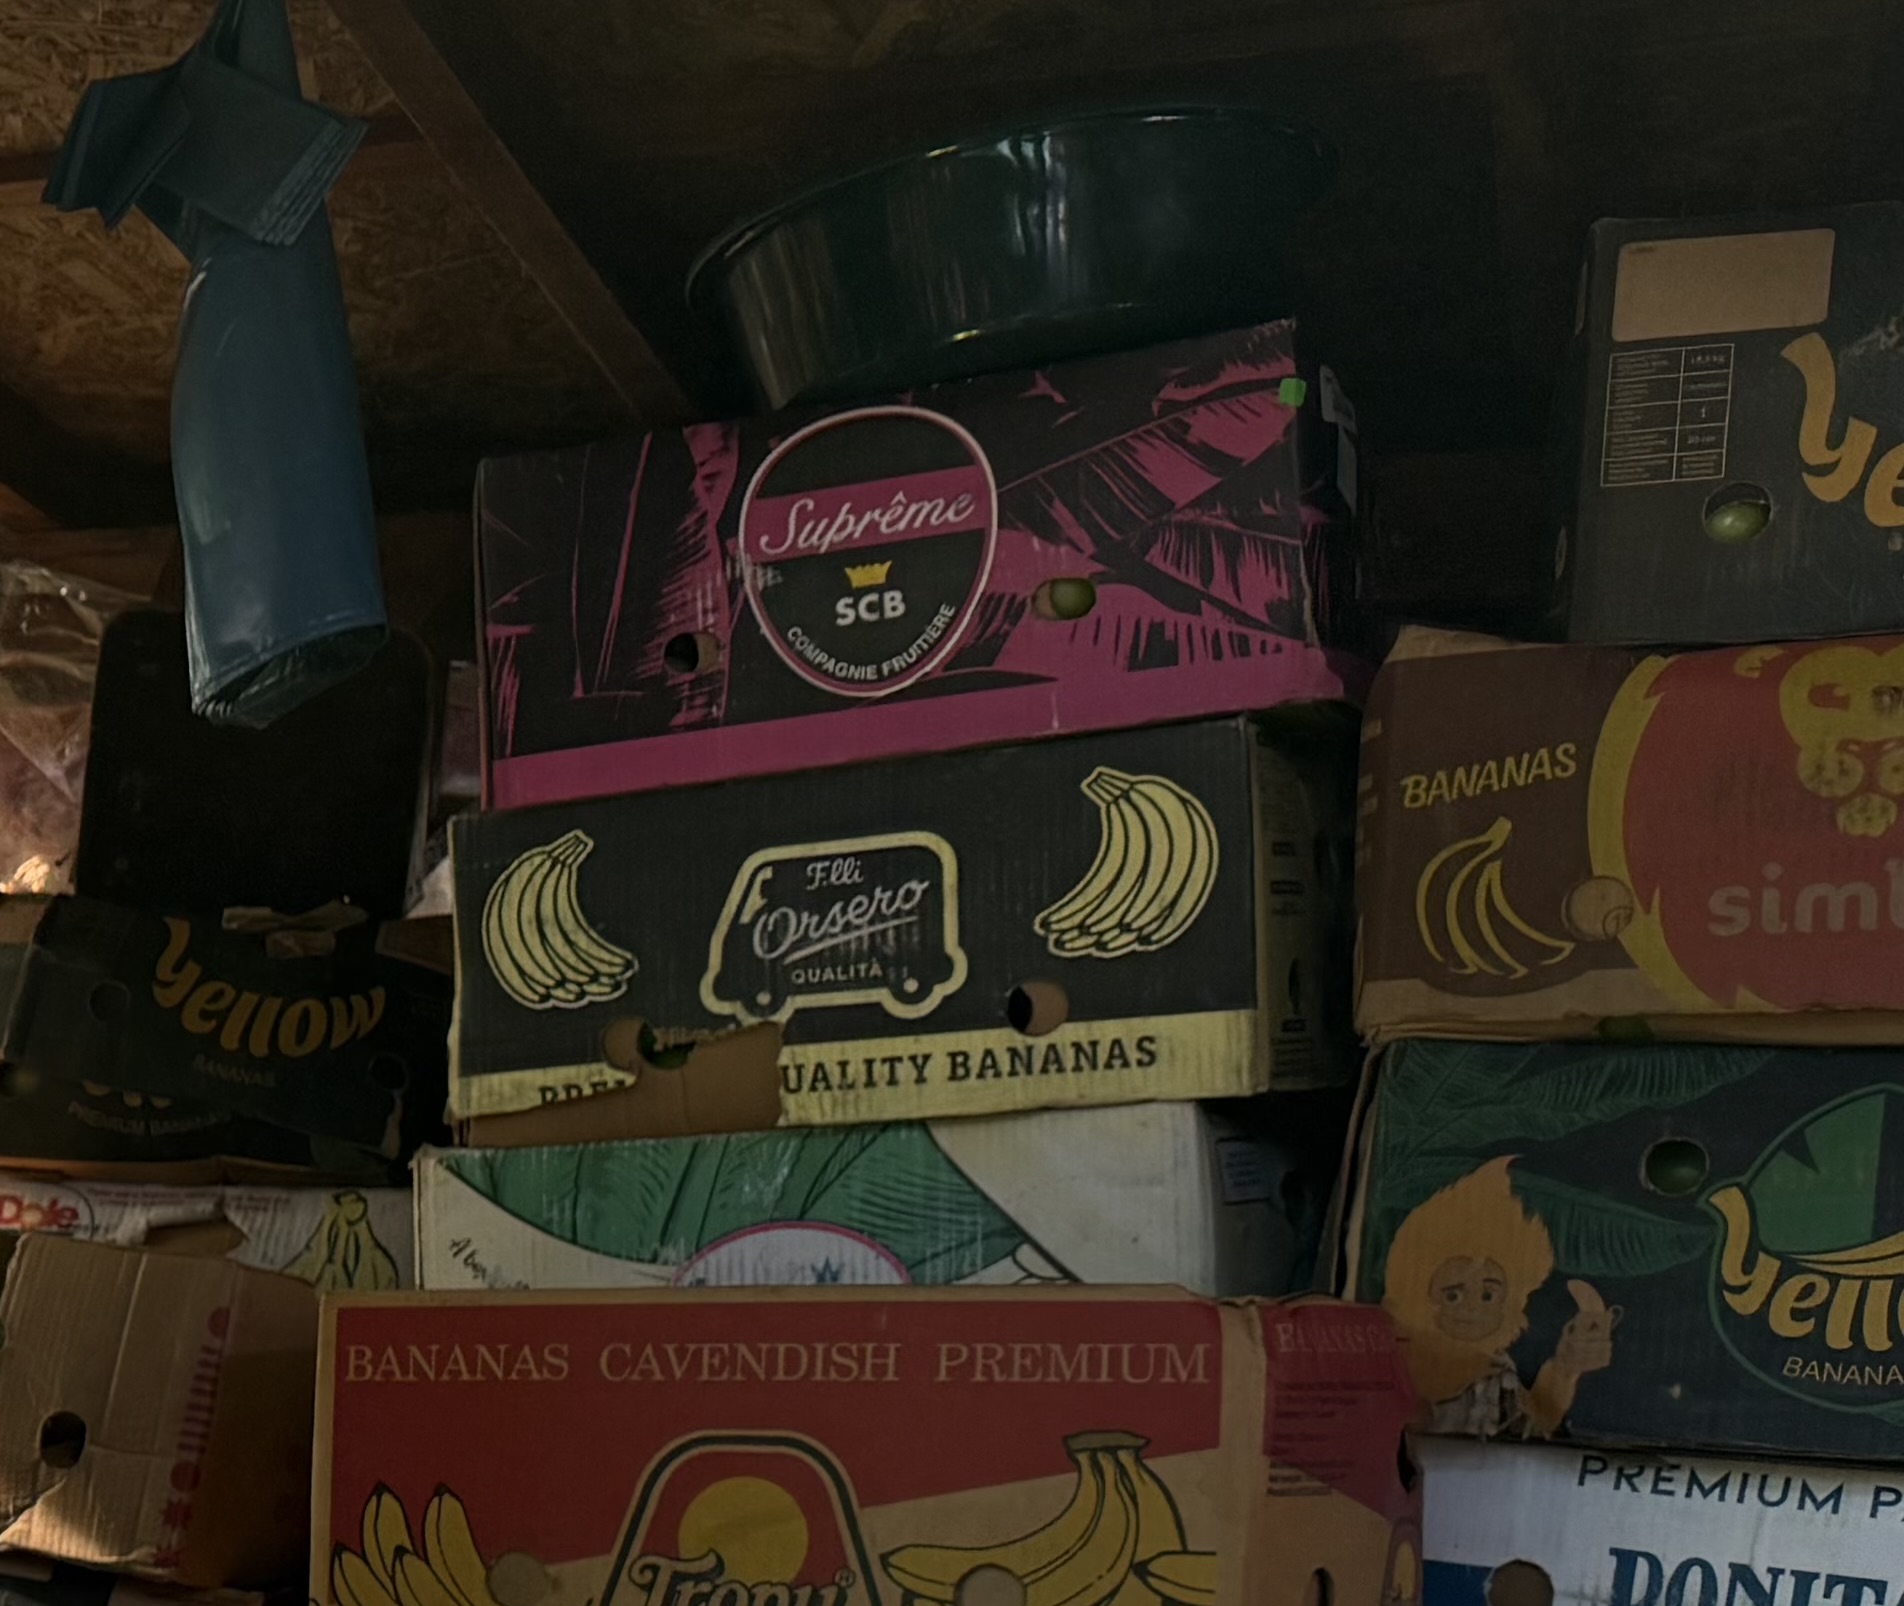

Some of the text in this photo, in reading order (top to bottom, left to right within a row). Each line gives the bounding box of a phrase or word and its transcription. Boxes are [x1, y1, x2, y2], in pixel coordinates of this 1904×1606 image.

[759, 490, 976, 554] Suprême
[835, 590, 906, 626] SCB
[787, 626, 879, 680] COMPAGNIE
[1400, 742, 1578, 809] BANANAS
[752, 880, 931, 961] Orsero
[792, 956, 884, 985] QUALITÀ
[947, 1035, 1157, 1083] BANANAS
[346, 1343, 1211, 1386] BANANAS CAVENDISH PREMIUM
[1577, 1454, 1904, 1519] PREMIUM P
